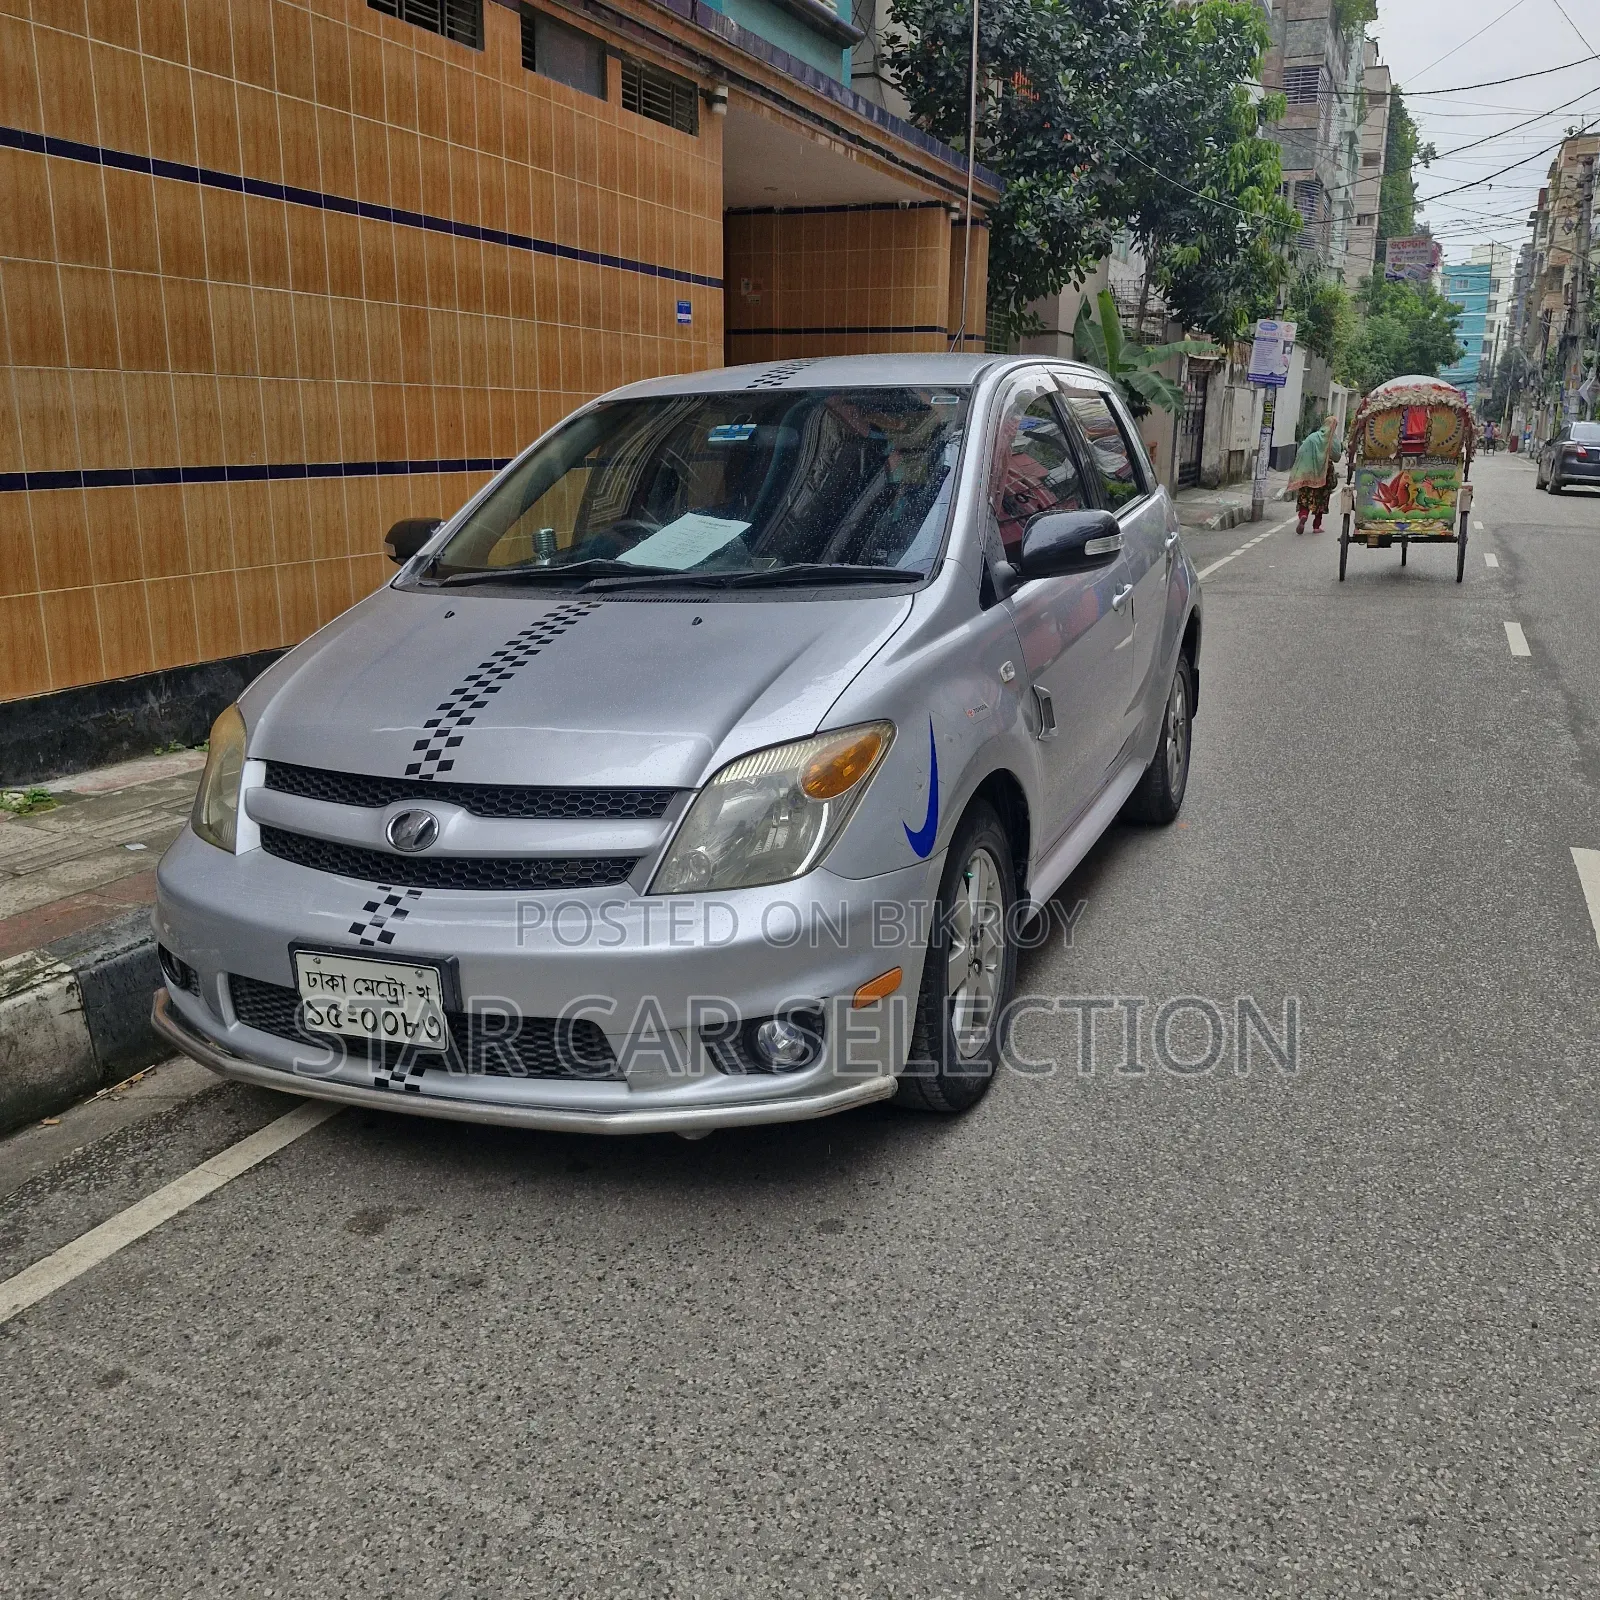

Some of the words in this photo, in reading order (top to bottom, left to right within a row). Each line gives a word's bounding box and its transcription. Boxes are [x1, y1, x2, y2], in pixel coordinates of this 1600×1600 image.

[973, 703, 988, 714] TOYOTA
[305, 971, 346, 994] ঢাকা
[305, 999, 442, 1042] ১৫-০০৮৩
